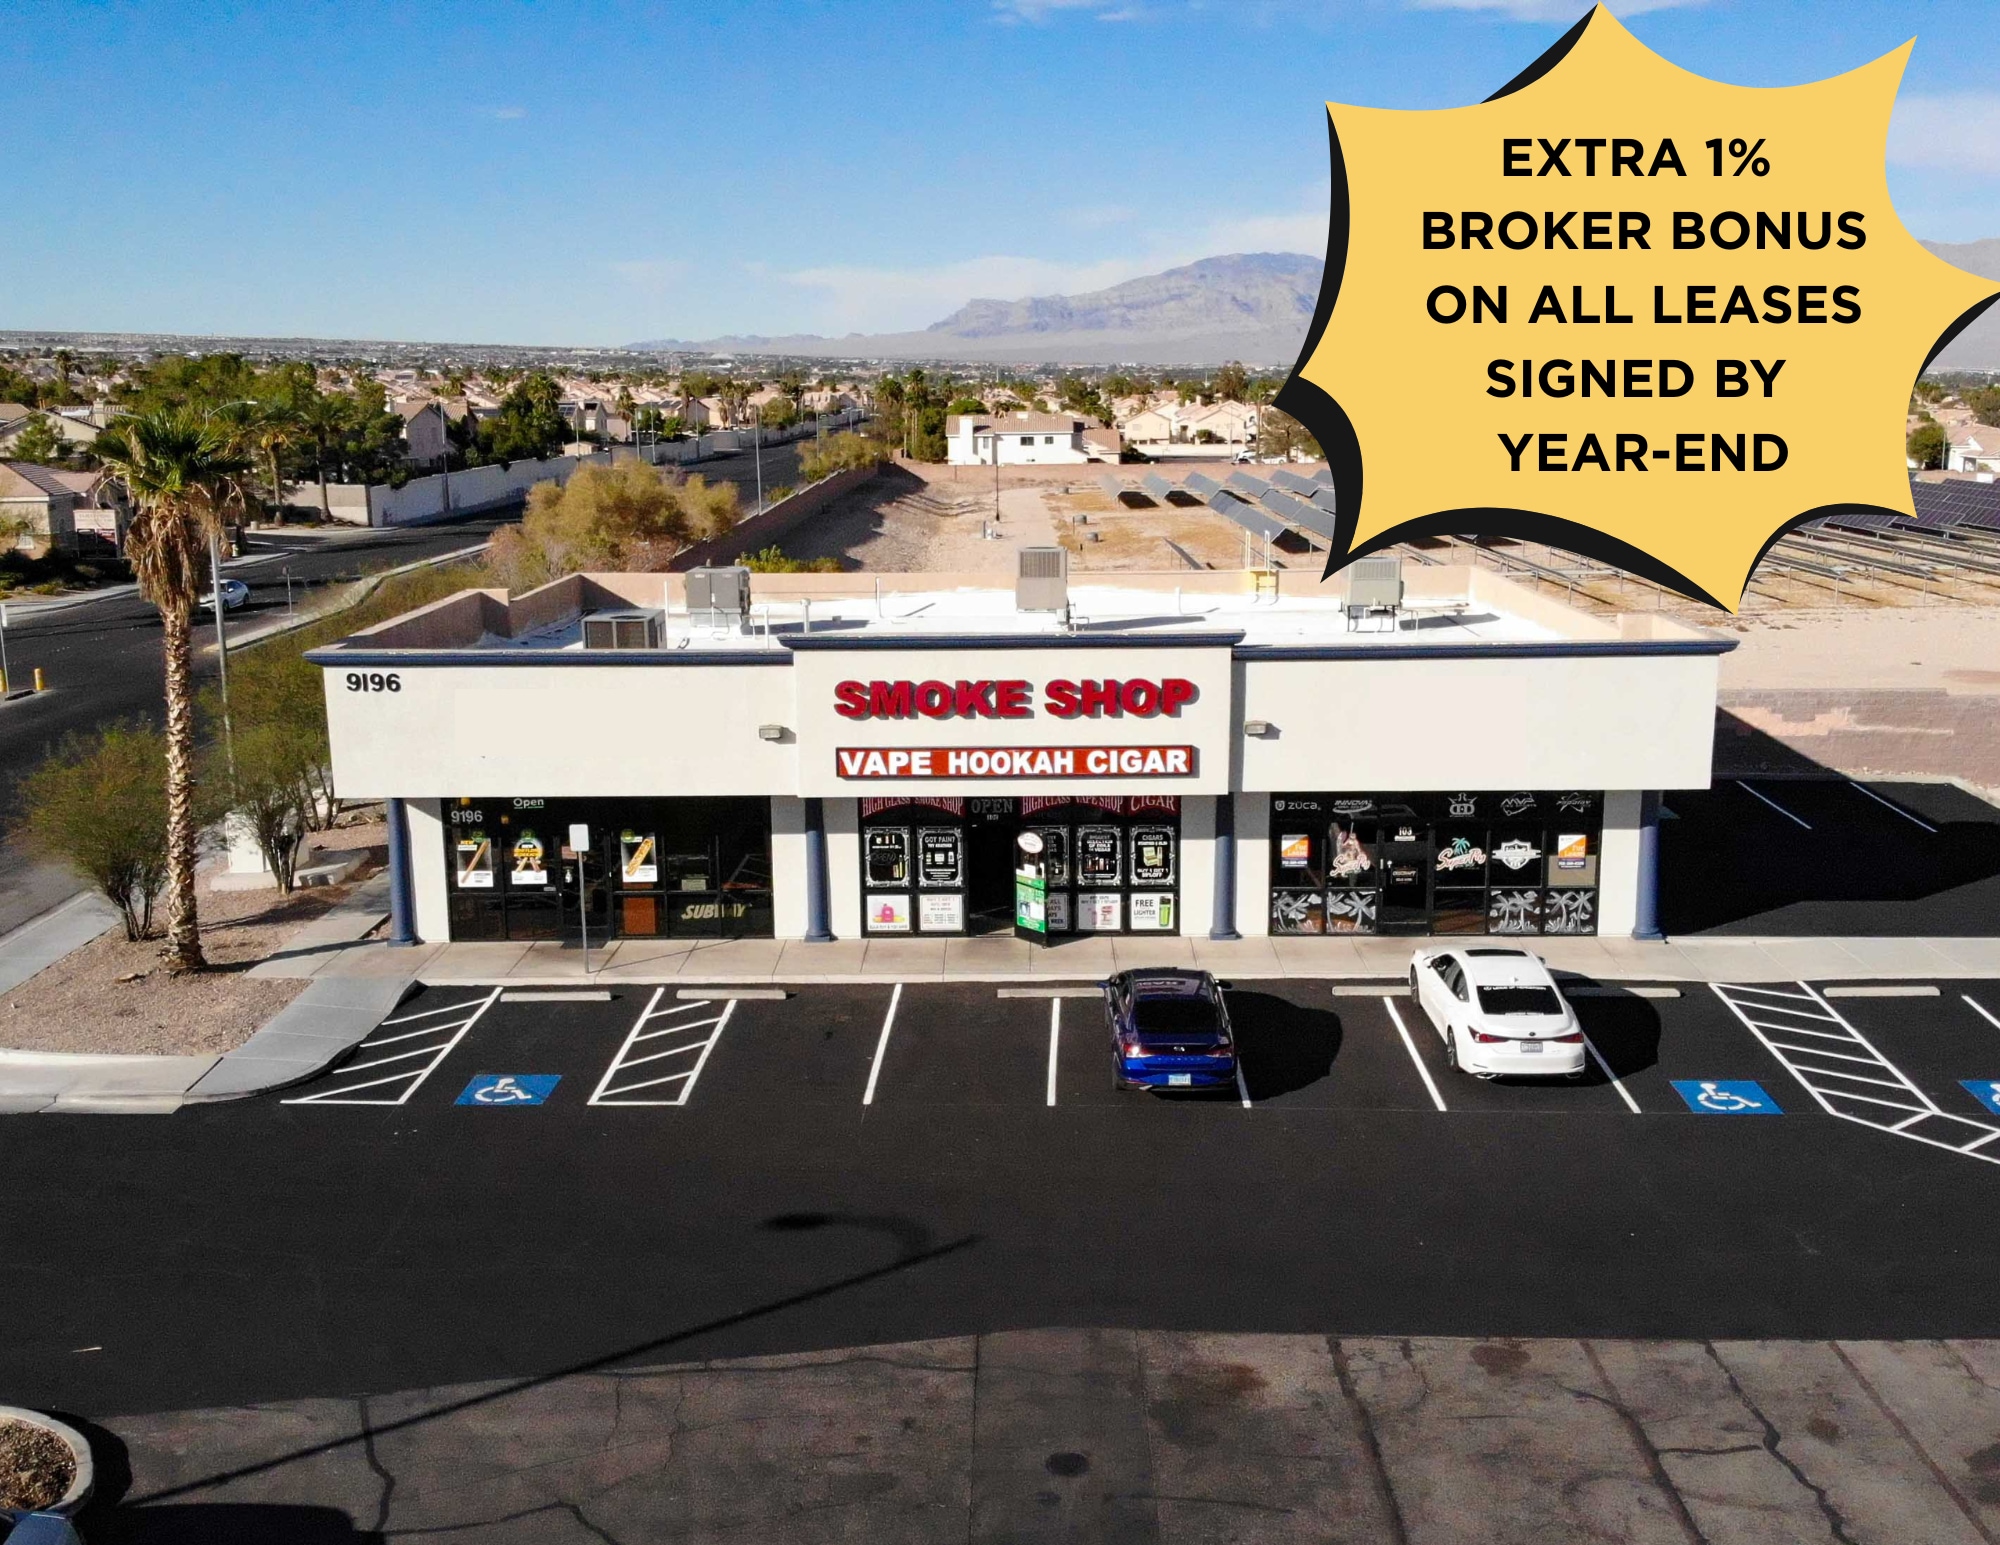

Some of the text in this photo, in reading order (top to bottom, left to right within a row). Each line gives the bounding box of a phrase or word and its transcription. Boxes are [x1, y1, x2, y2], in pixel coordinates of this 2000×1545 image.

[346, 672, 402, 693] 9196
[835, 678, 1196, 718] SMOKE SHOP
[839, 749, 1188, 776] VAPE HOOKAH CIGAR
[513, 798, 544, 809] Open
[942, 797, 964, 815] SHOP
[971, 798, 1013, 814] OPEN
[1022, 796, 1043, 815] HIGH
[1098, 796, 1123, 813] SHOP
[1131, 796, 1175, 811] CIGAR
[451, 810, 483, 824] 9196
[1399, 827, 1413, 836] 103
[1135, 899, 1154, 907] FREE
